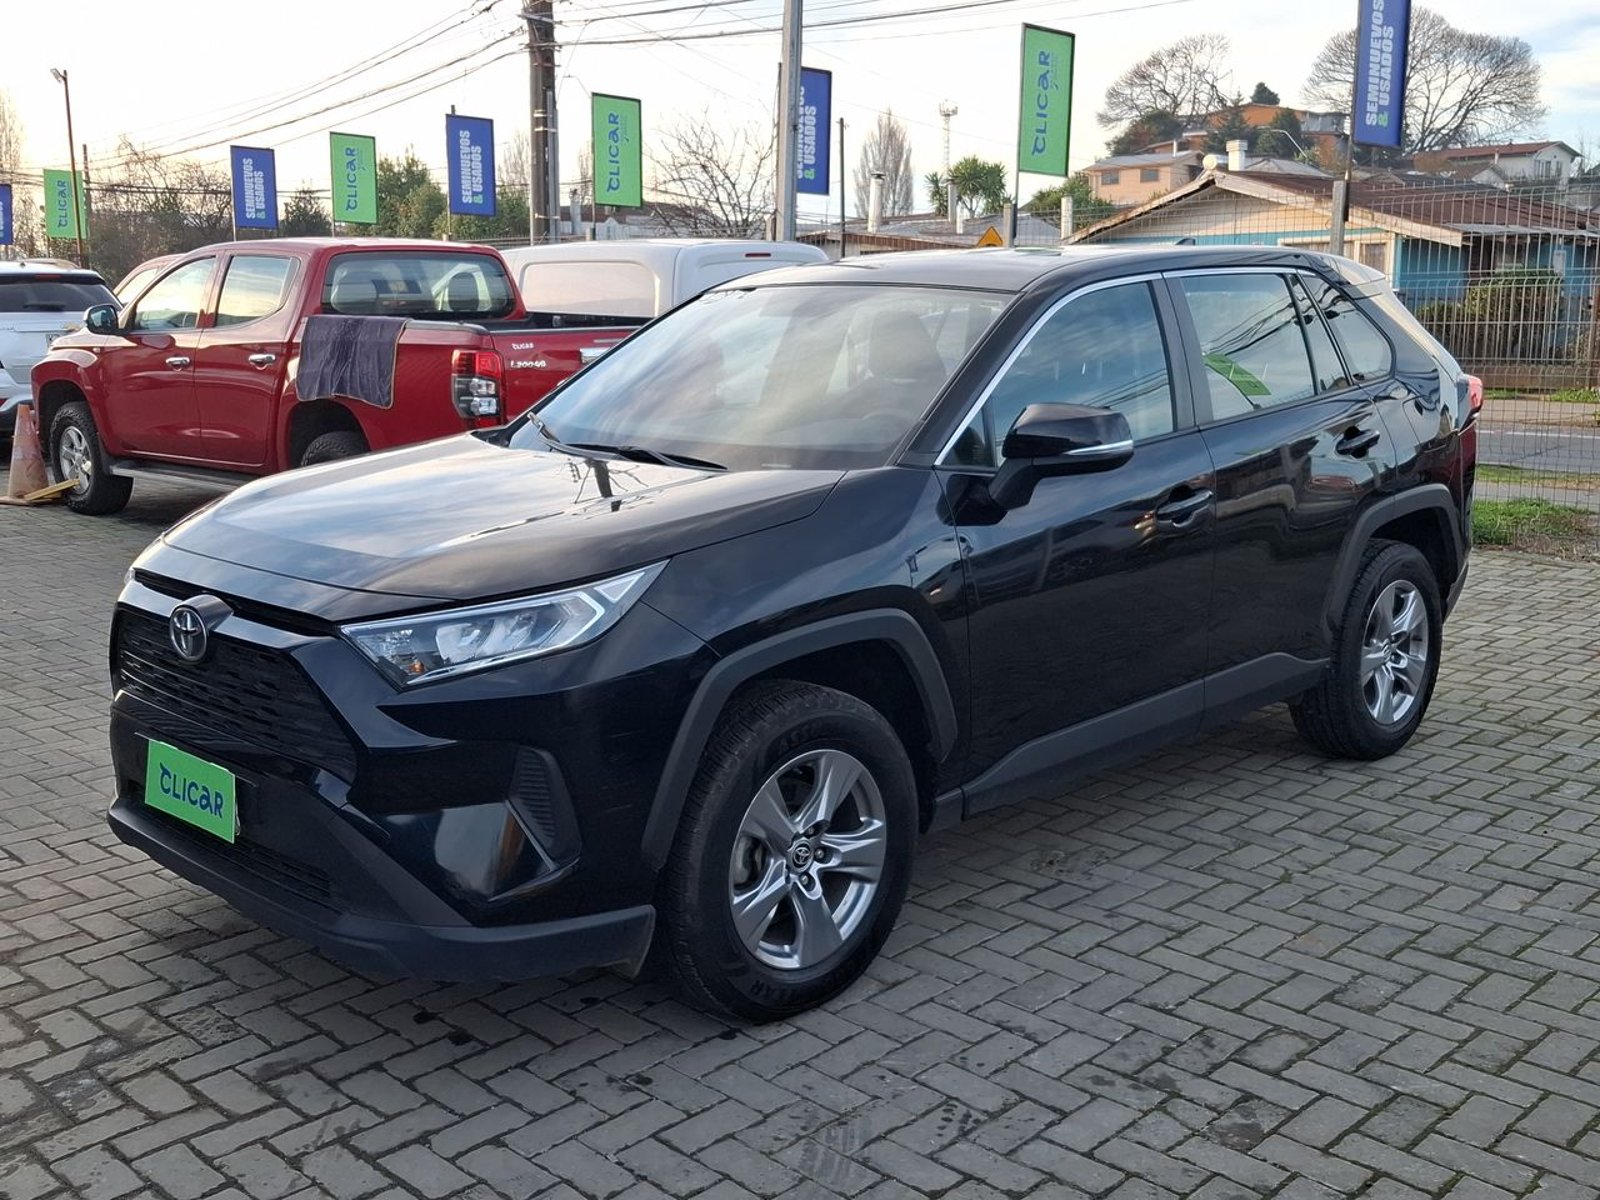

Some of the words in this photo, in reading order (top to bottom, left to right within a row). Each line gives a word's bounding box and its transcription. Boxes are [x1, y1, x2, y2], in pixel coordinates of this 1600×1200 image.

[1379, 25, 1394, 106] USADOS
[805, 105, 817, 166] USADOS
[1377, 112, 1389, 128] &
[243, 158, 256, 219] SEMINUEVOS
[459, 130, 472, 204] SEMINUEVOS
[471, 145, 483, 192] USADOS
[805, 168, 817, 180] &
[254, 170, 265, 210] USADOS
[474, 194, 484, 204] &
[256, 211, 266, 219] &
